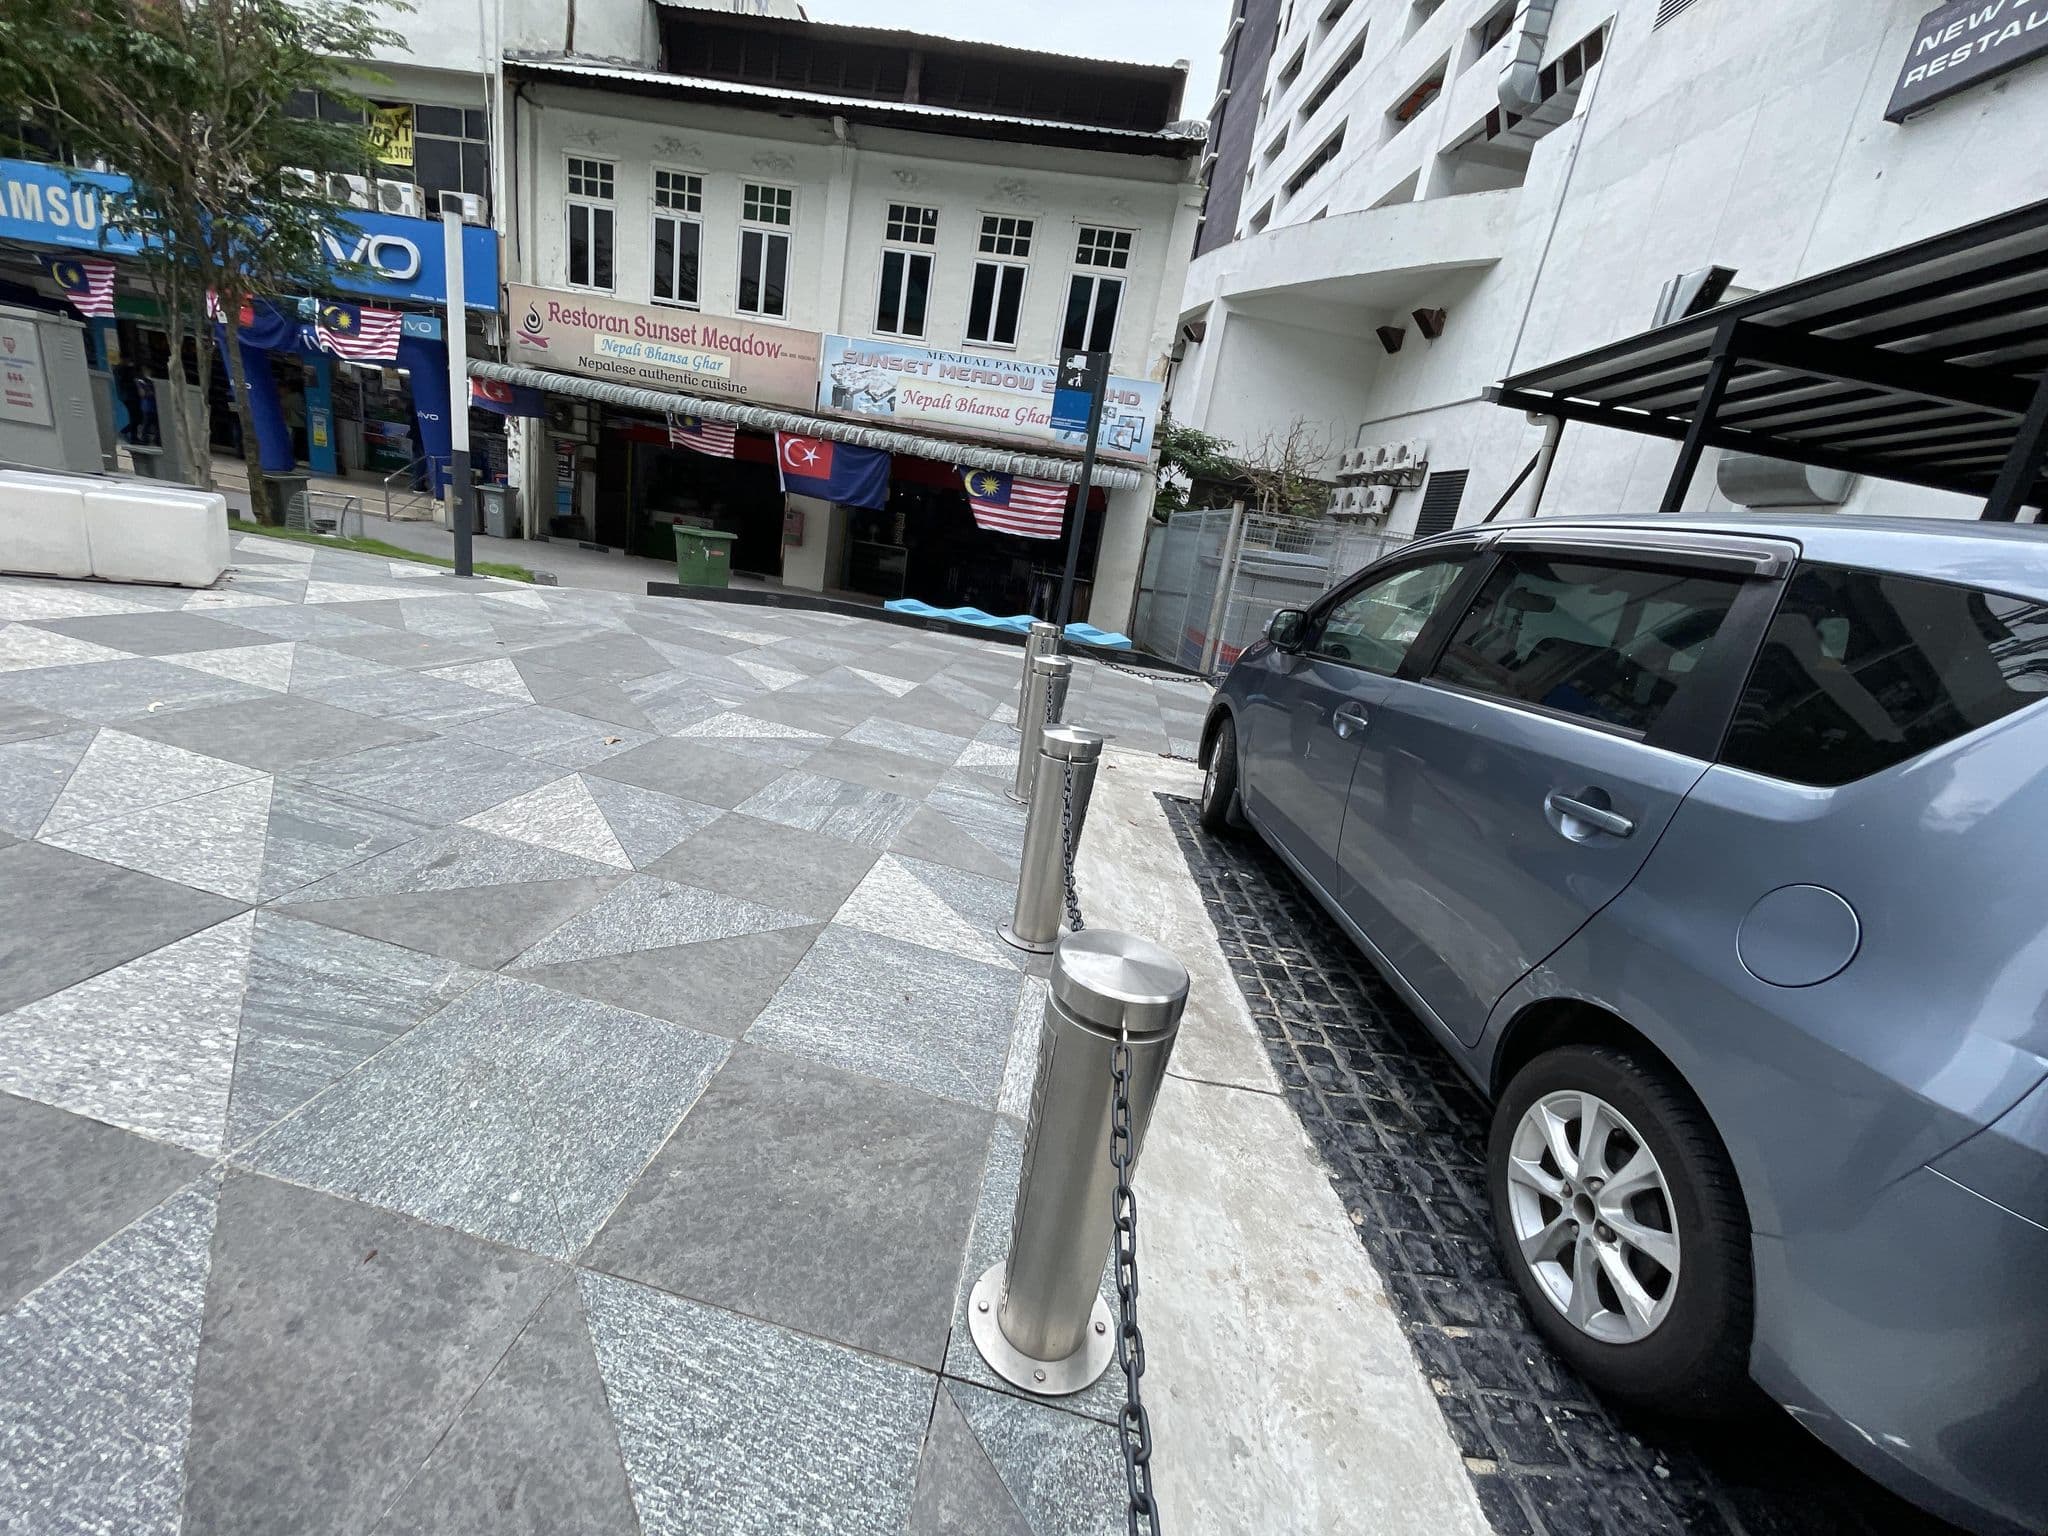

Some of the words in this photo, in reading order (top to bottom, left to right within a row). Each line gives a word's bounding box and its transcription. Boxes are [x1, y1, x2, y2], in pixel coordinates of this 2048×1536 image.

[1915, 0, 2005, 57] NEW
[547, 301, 630, 334] Restoran
[634, 315, 697, 346] Sunset
[701, 326, 783, 359] Meadow
[601, 338, 643, 357] Nepali
[644, 346, 688, 365] Bhansa
[692, 354, 724, 372] Ghar
[842, 350, 933, 375] SUNSET
[938, 363, 1035, 391] MEADOW
[926, 351, 990, 368] MENJUAL
[995, 361, 1057, 376] PAKAIAN
[578, 356, 636, 375] Nepalese
[639, 367, 699, 386] authentic
[701, 378, 748, 395] cuisine
[902, 389, 952, 412] Nepali
[955, 397, 1010, 418] Bhansa
[1015, 404, 1051, 426] Ghar
